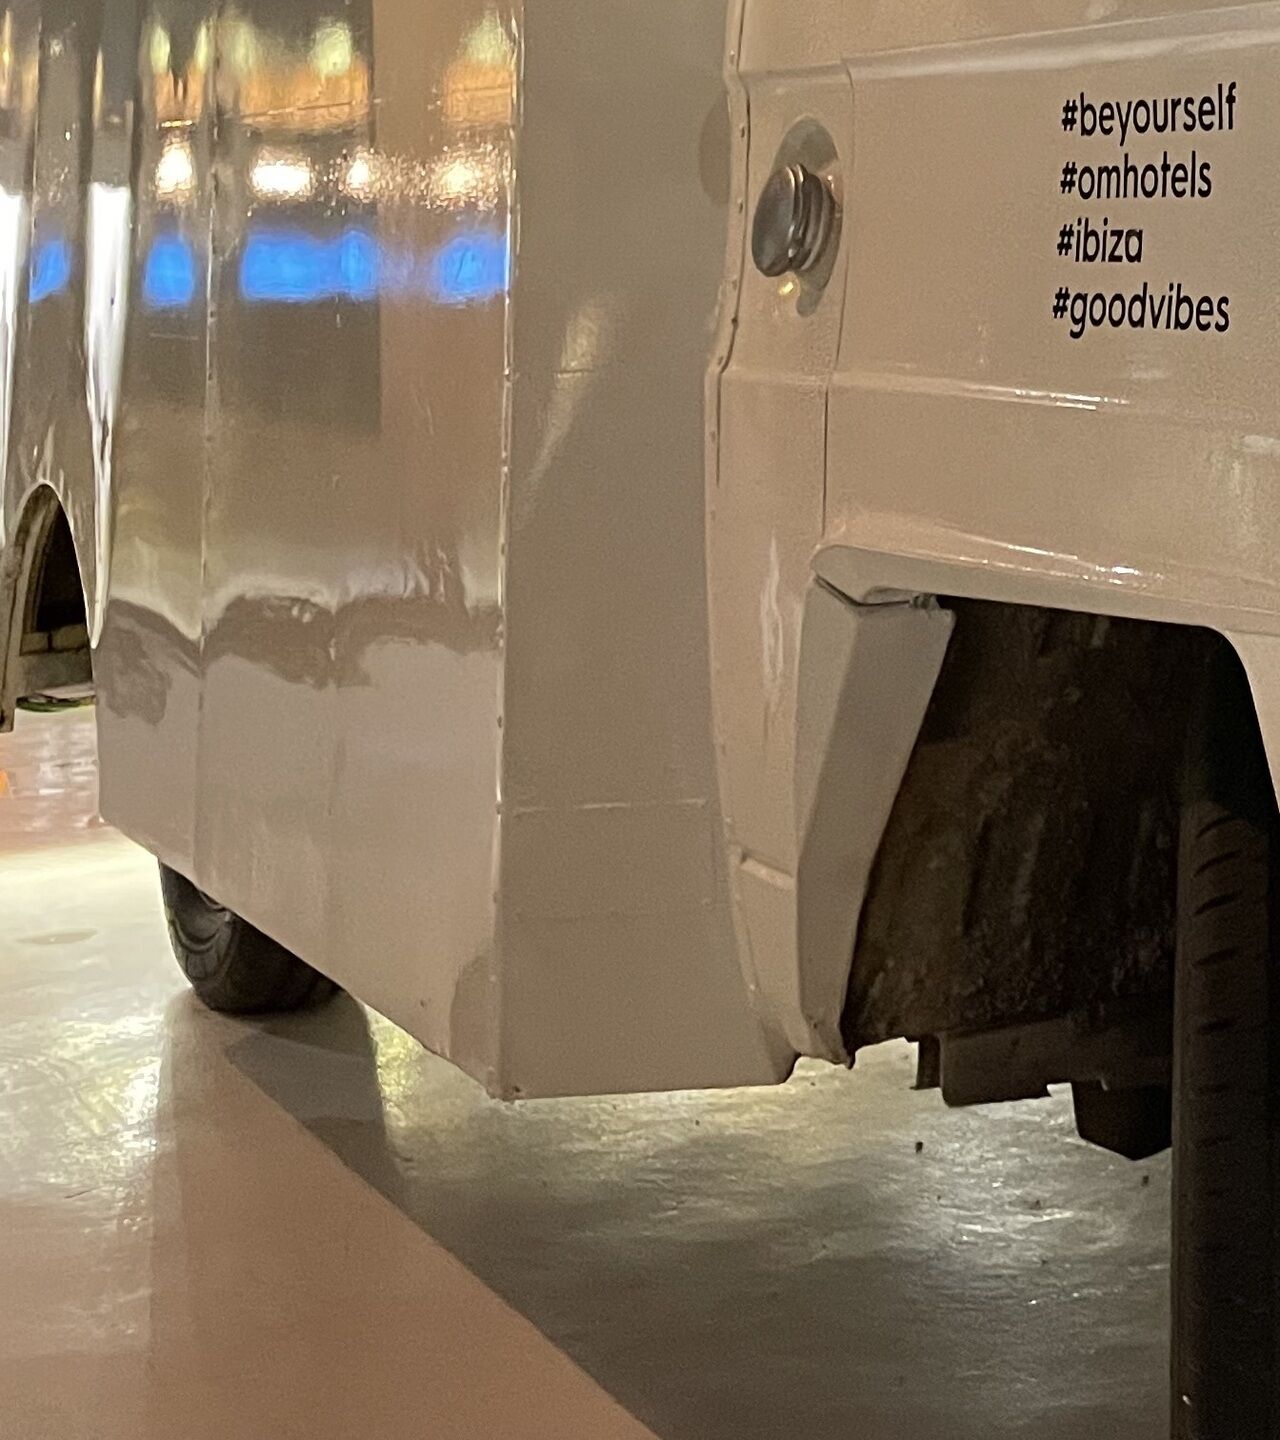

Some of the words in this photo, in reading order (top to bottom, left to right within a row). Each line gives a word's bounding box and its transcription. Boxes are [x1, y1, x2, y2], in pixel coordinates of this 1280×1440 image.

[1061, 81, 1237, 147] #beyourself
[1060, 150, 1213, 200] #omhotels
[1056, 217, 1144, 263] #ibiza
[1052, 281, 1230, 339] #goodvibes
